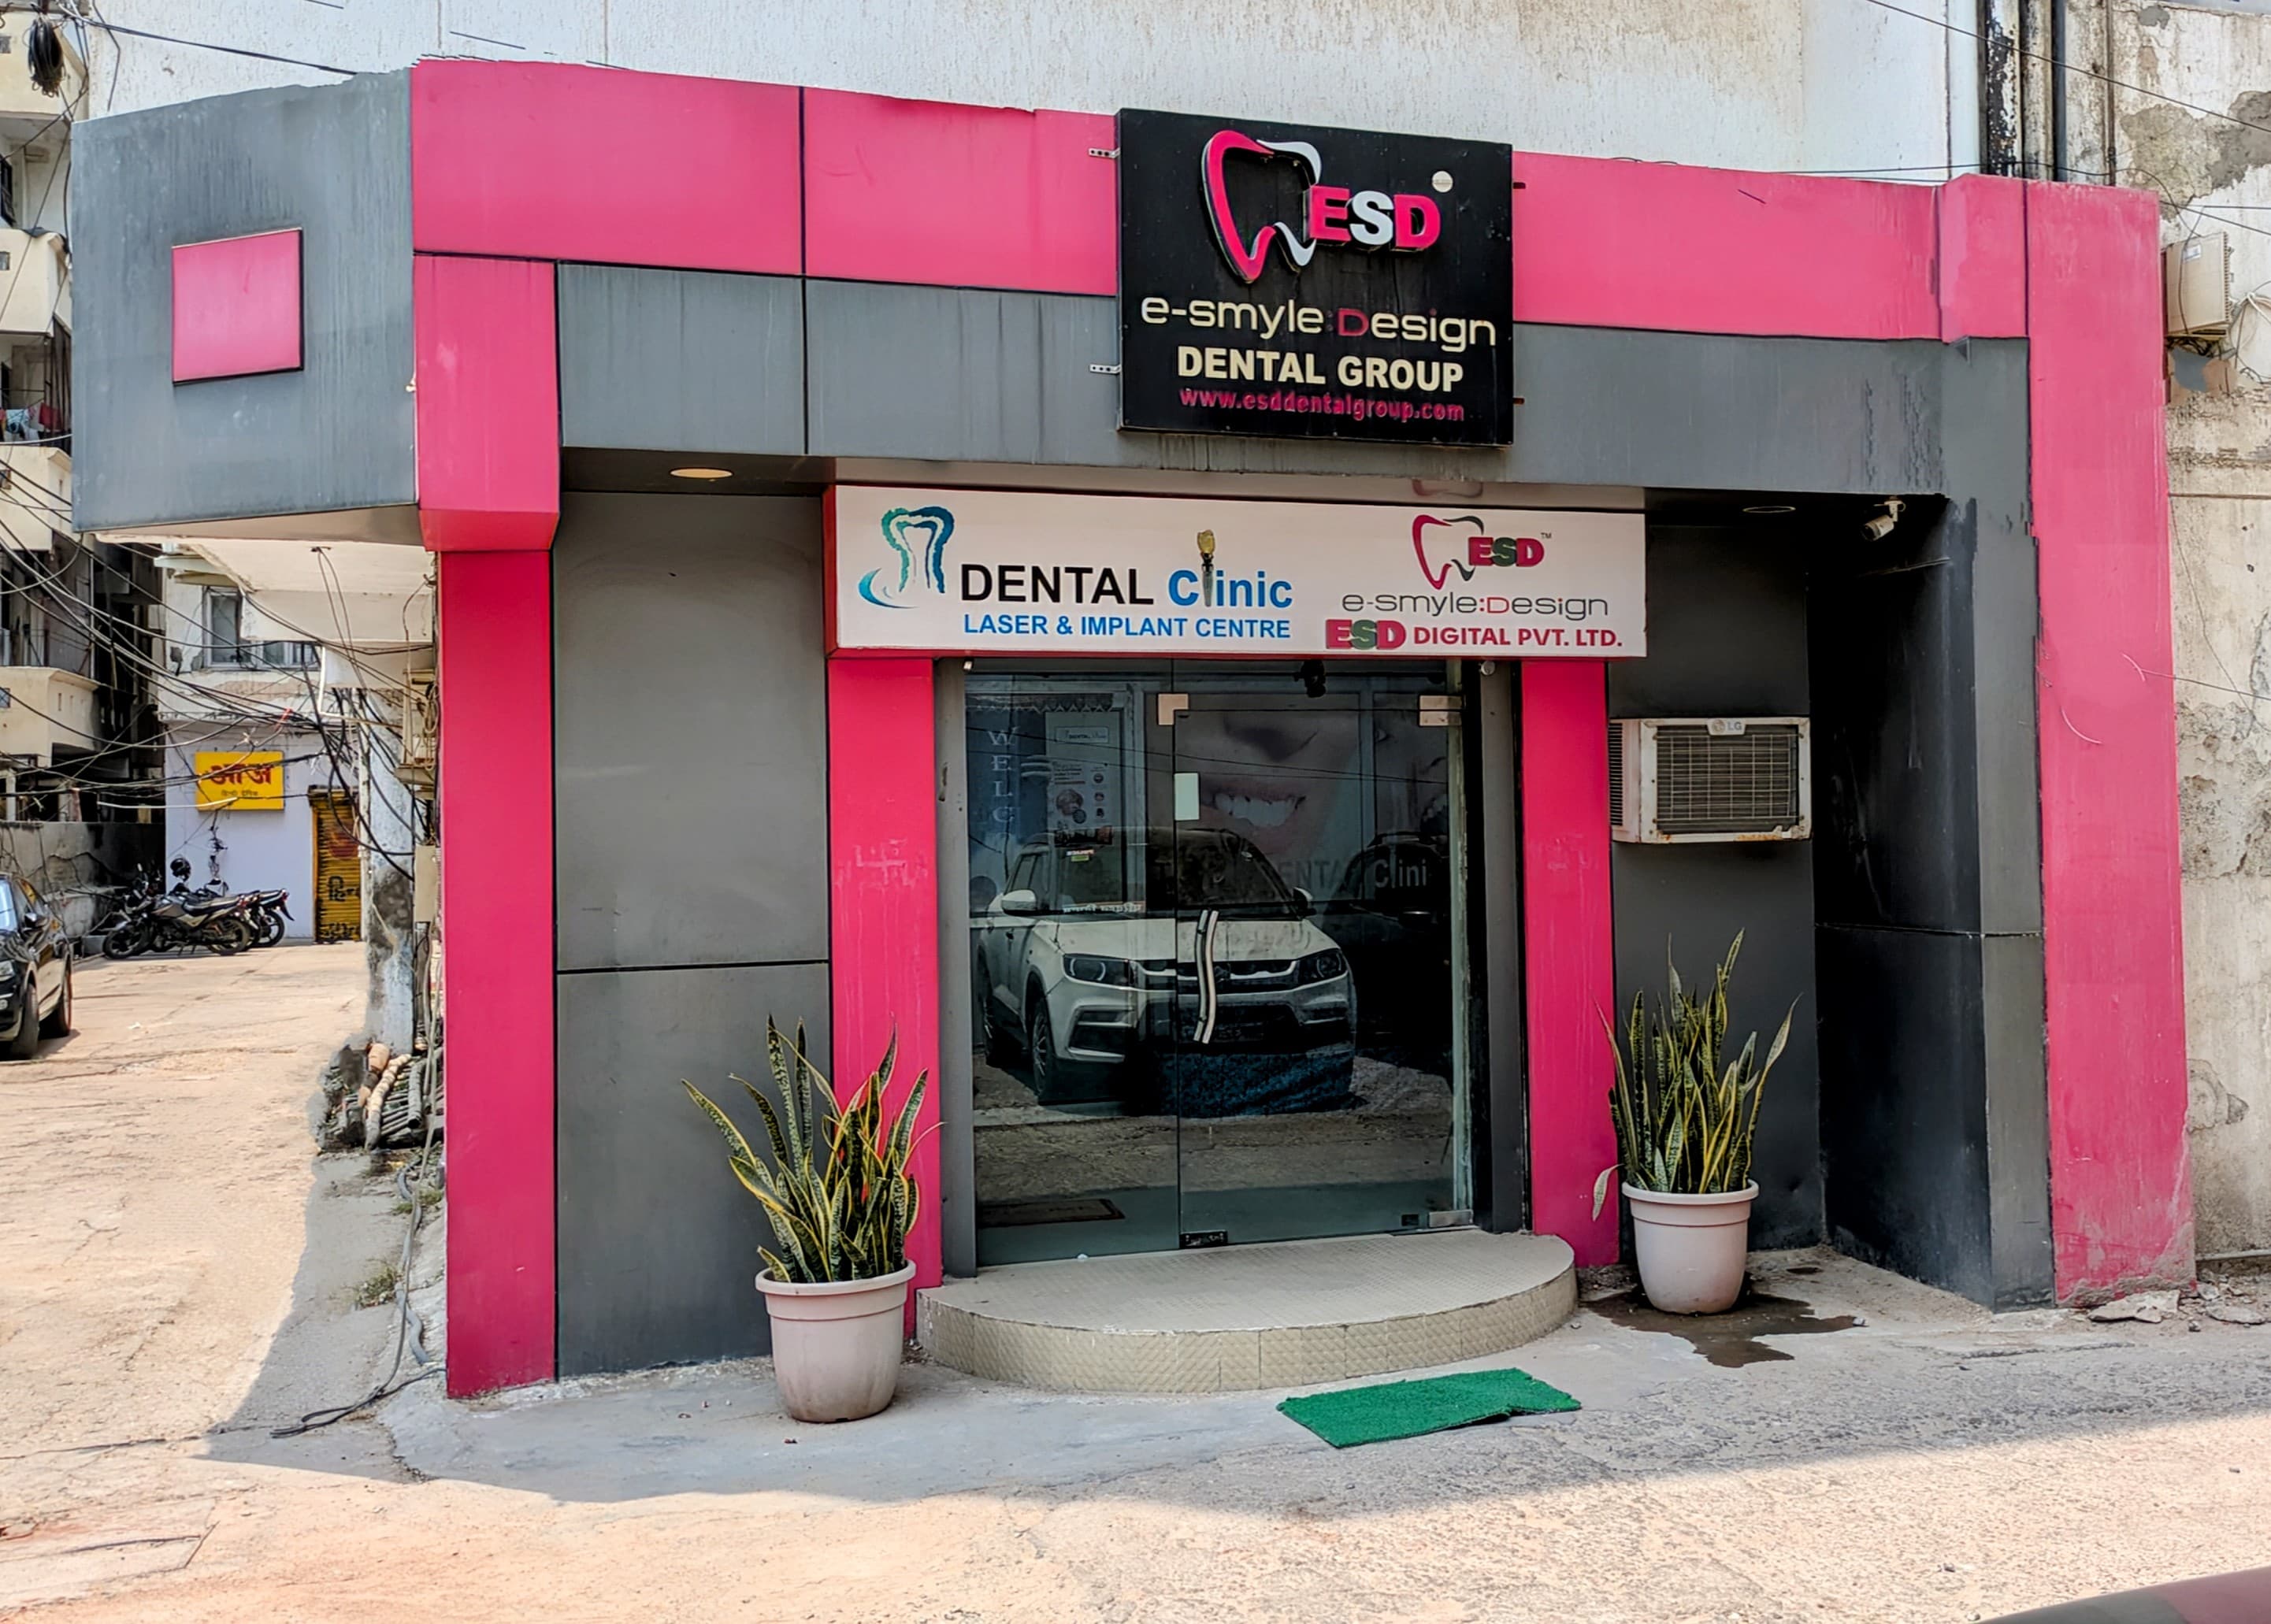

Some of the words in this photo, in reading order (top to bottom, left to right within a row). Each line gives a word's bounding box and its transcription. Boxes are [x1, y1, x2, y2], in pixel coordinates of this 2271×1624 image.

[1309, 184, 1441, 250] ESD
[1178, 346, 1326, 384] DENTAL
[1338, 355, 1464, 392] GROUP
[1180, 387, 1464, 423] www.esddentalgroup.com
[1468, 536, 1545, 567] ESD
[961, 564, 1154, 605] DENTAL
[963, 614, 1048, 635] LASER
[1056, 614, 1073, 636] &
[1080, 616, 1187, 637] IMPLANT
[1194, 617, 1290, 640] CENTRE
[1325, 619, 1406, 651] ESD
[1413, 627, 1511, 646] DIGITAL
[1518, 628, 1569, 647] PVT.
[1575, 628, 1623, 647] LTD.
[1727, 722, 1742, 731] LG
